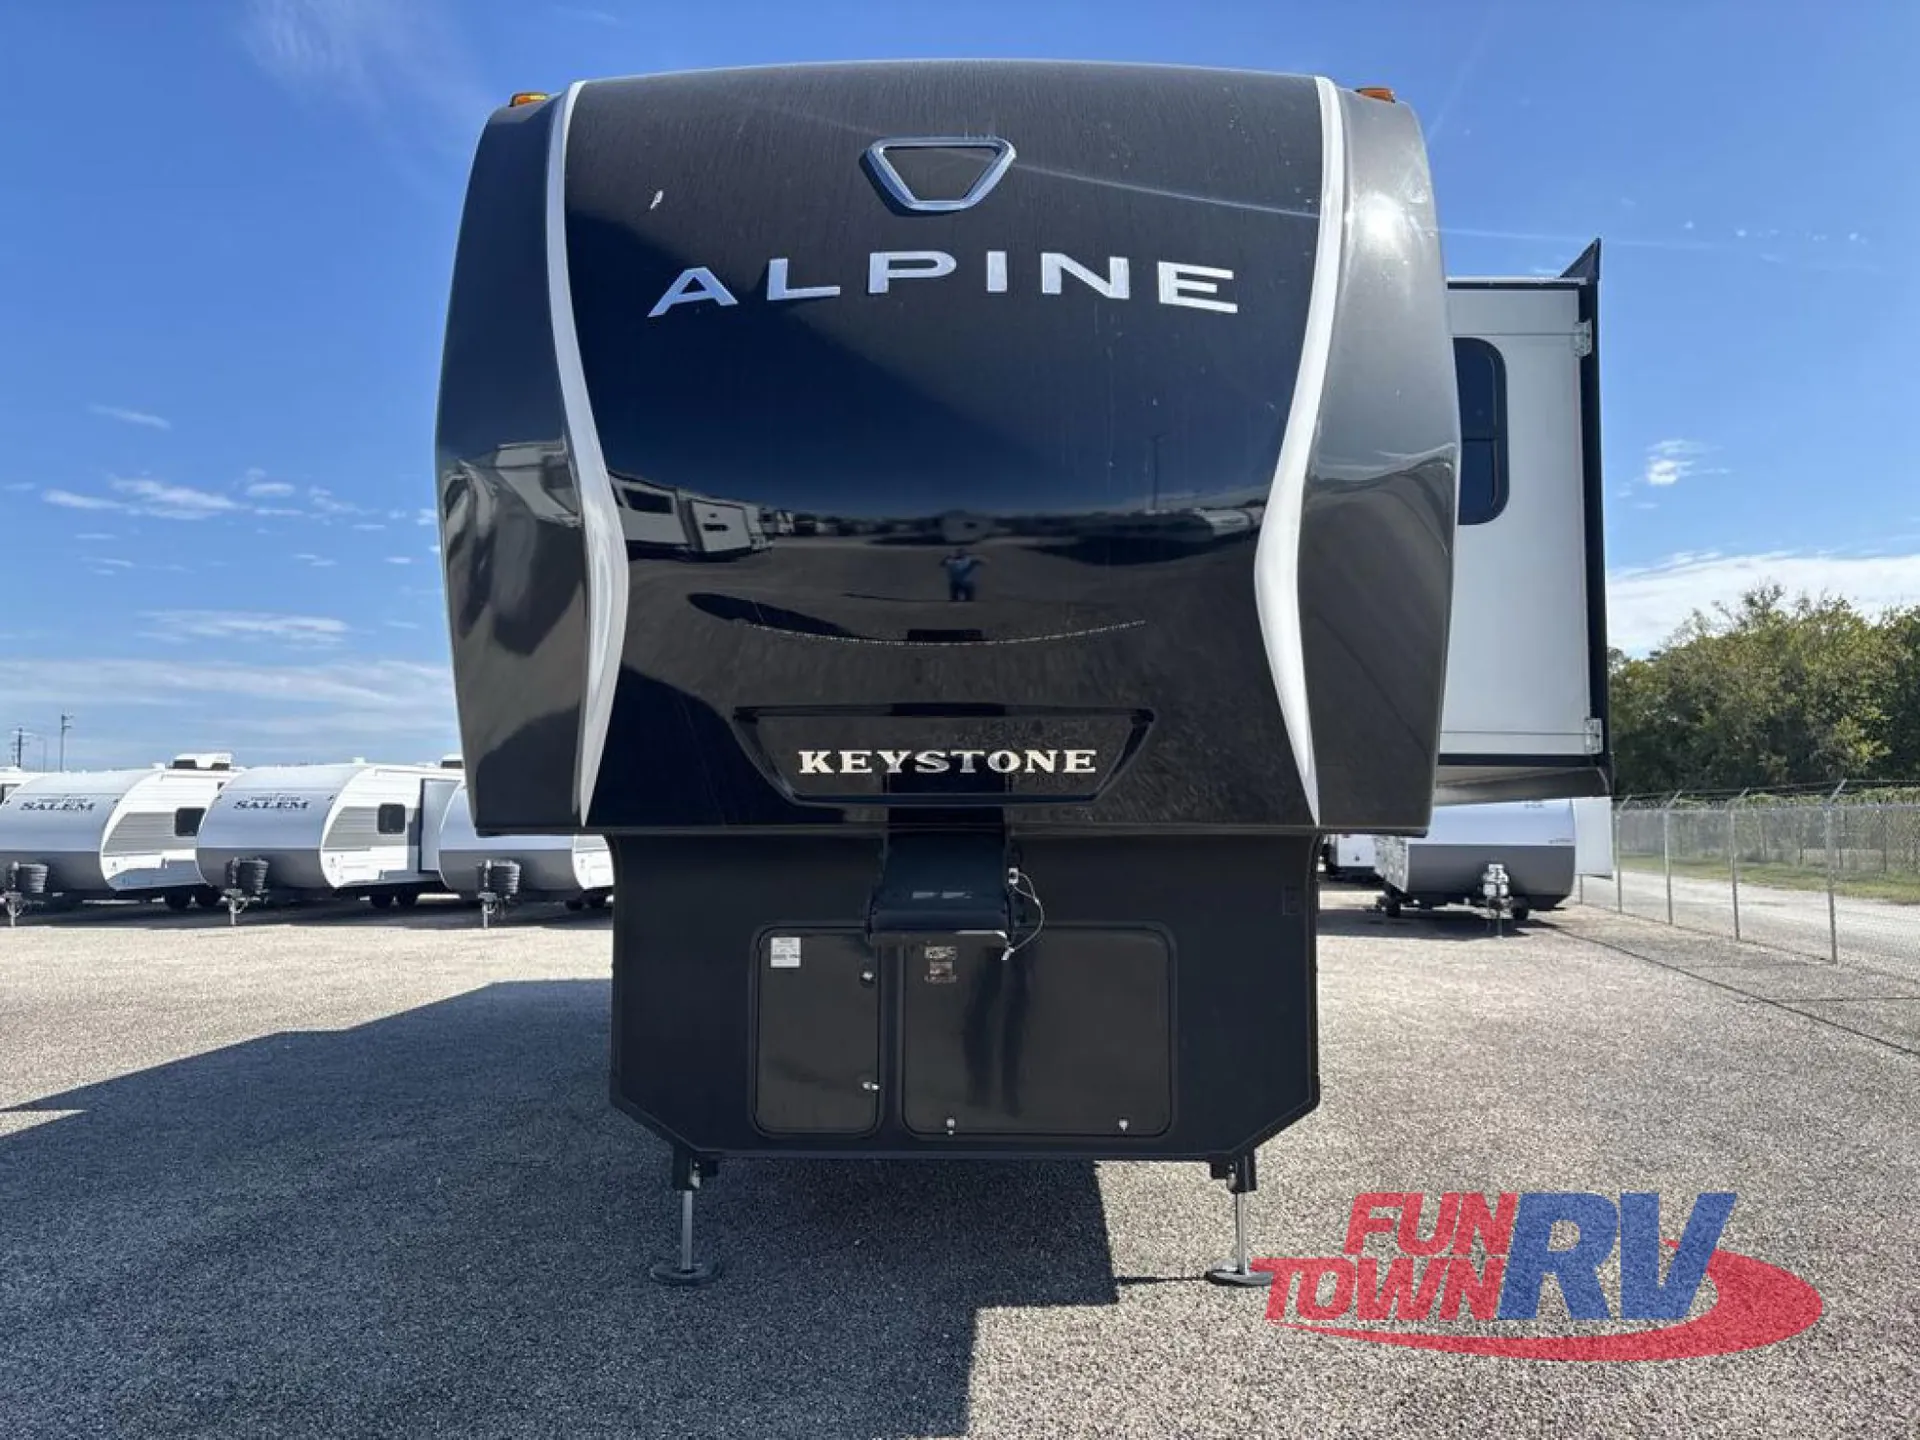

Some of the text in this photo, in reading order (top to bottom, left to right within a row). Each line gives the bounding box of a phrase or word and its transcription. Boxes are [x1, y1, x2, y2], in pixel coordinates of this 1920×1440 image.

[647, 251, 1238, 317] ALPINE
[798, 749, 1097, 774] KEYSTONE
[19, 802, 96, 811] SALEM
[233, 800, 310, 809] SALEM
